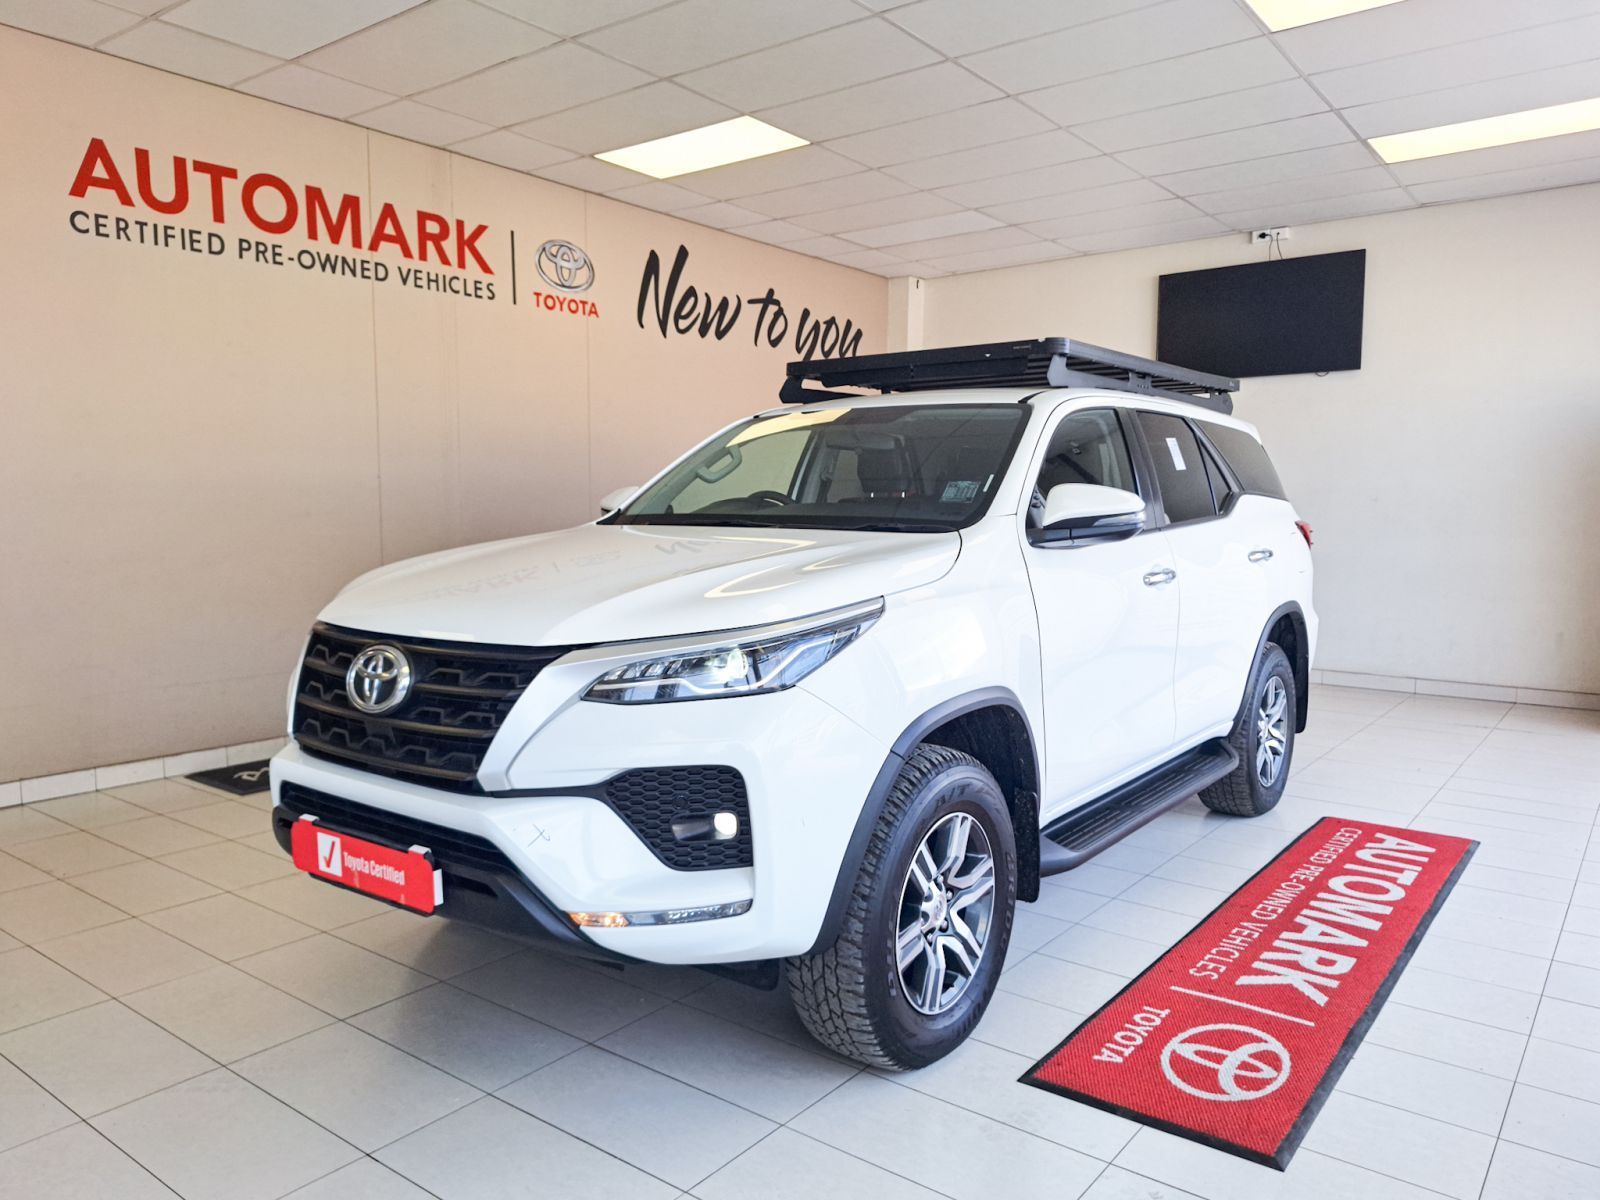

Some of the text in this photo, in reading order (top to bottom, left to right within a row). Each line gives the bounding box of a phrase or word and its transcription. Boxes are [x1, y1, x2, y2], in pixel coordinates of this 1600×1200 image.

[69, 138, 495, 276] AUTOMARK
[69, 210, 496, 301] CERTIFIED PRE-OWNED VEHICLES
[533, 291, 600, 318] TOYOTA
[637, 244, 864, 363] New to you
[342, 851, 405, 886] Toyota Certified
[1188, 827, 1363, 980] CERTIFIED PRE-OWNED VEHICLES
[1234, 832, 1438, 1008] AUTOMARK
[1092, 1005, 1171, 1064] TOYOTA
